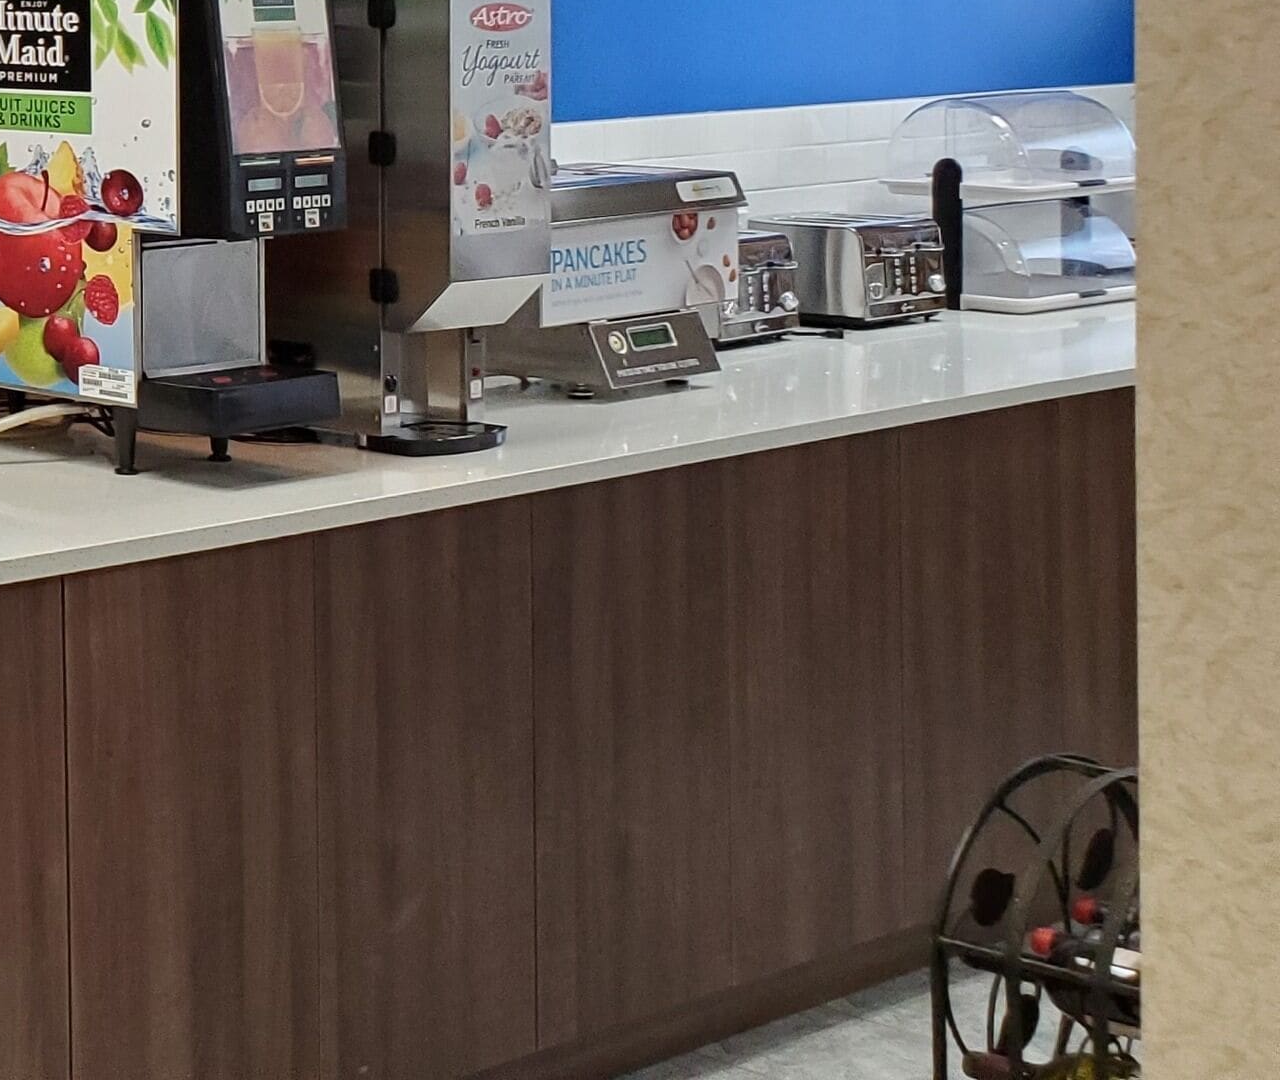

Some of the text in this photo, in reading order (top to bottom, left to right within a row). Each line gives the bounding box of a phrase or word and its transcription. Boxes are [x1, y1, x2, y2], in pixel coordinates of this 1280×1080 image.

[20, 0, 48, 8] ENJOY
[471, 7, 533, 27] Astro
[462, 44, 541, 87] Yogourt
[0, 71, 58, 83] PREMIUM
[26, 99, 76, 115] JUICES
[10, 113, 61, 129] DRINKS
[551, 239, 648, 274] PANCAKES
[565, 277, 573, 289] A
[575, 273, 613, 289] MINUTE
[614, 269, 637, 283] FLAT
